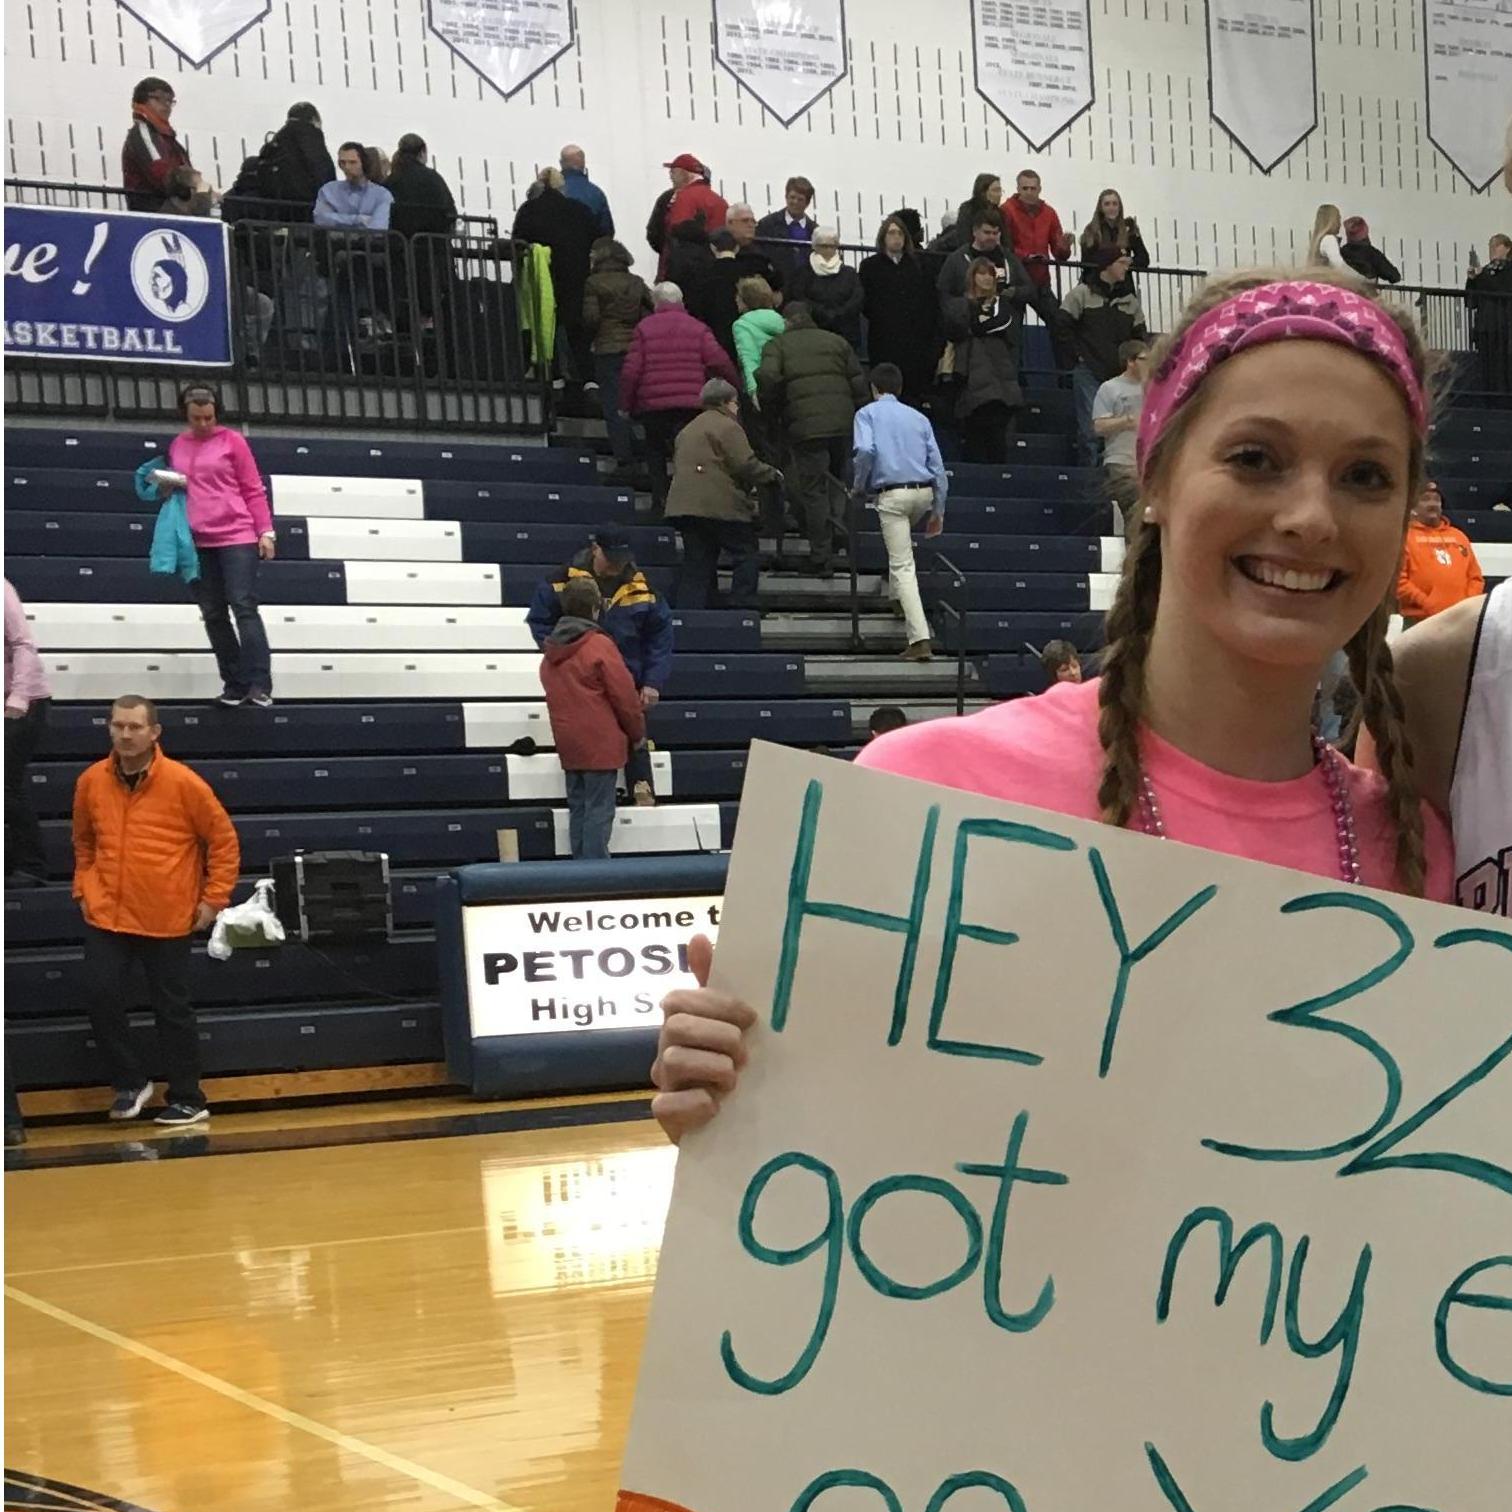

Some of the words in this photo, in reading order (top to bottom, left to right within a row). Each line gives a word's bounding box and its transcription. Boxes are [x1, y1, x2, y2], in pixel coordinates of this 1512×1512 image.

[528, 908, 695, 933] Welcome
[707, 904, 720, 926] t
[772, 779, 1217, 1077] HEY
[531, 996, 617, 1026] High
[634, 992, 656, 1014] S
[720, 1108, 1068, 1396] got
[1156, 1206, 1372, 1463] my
